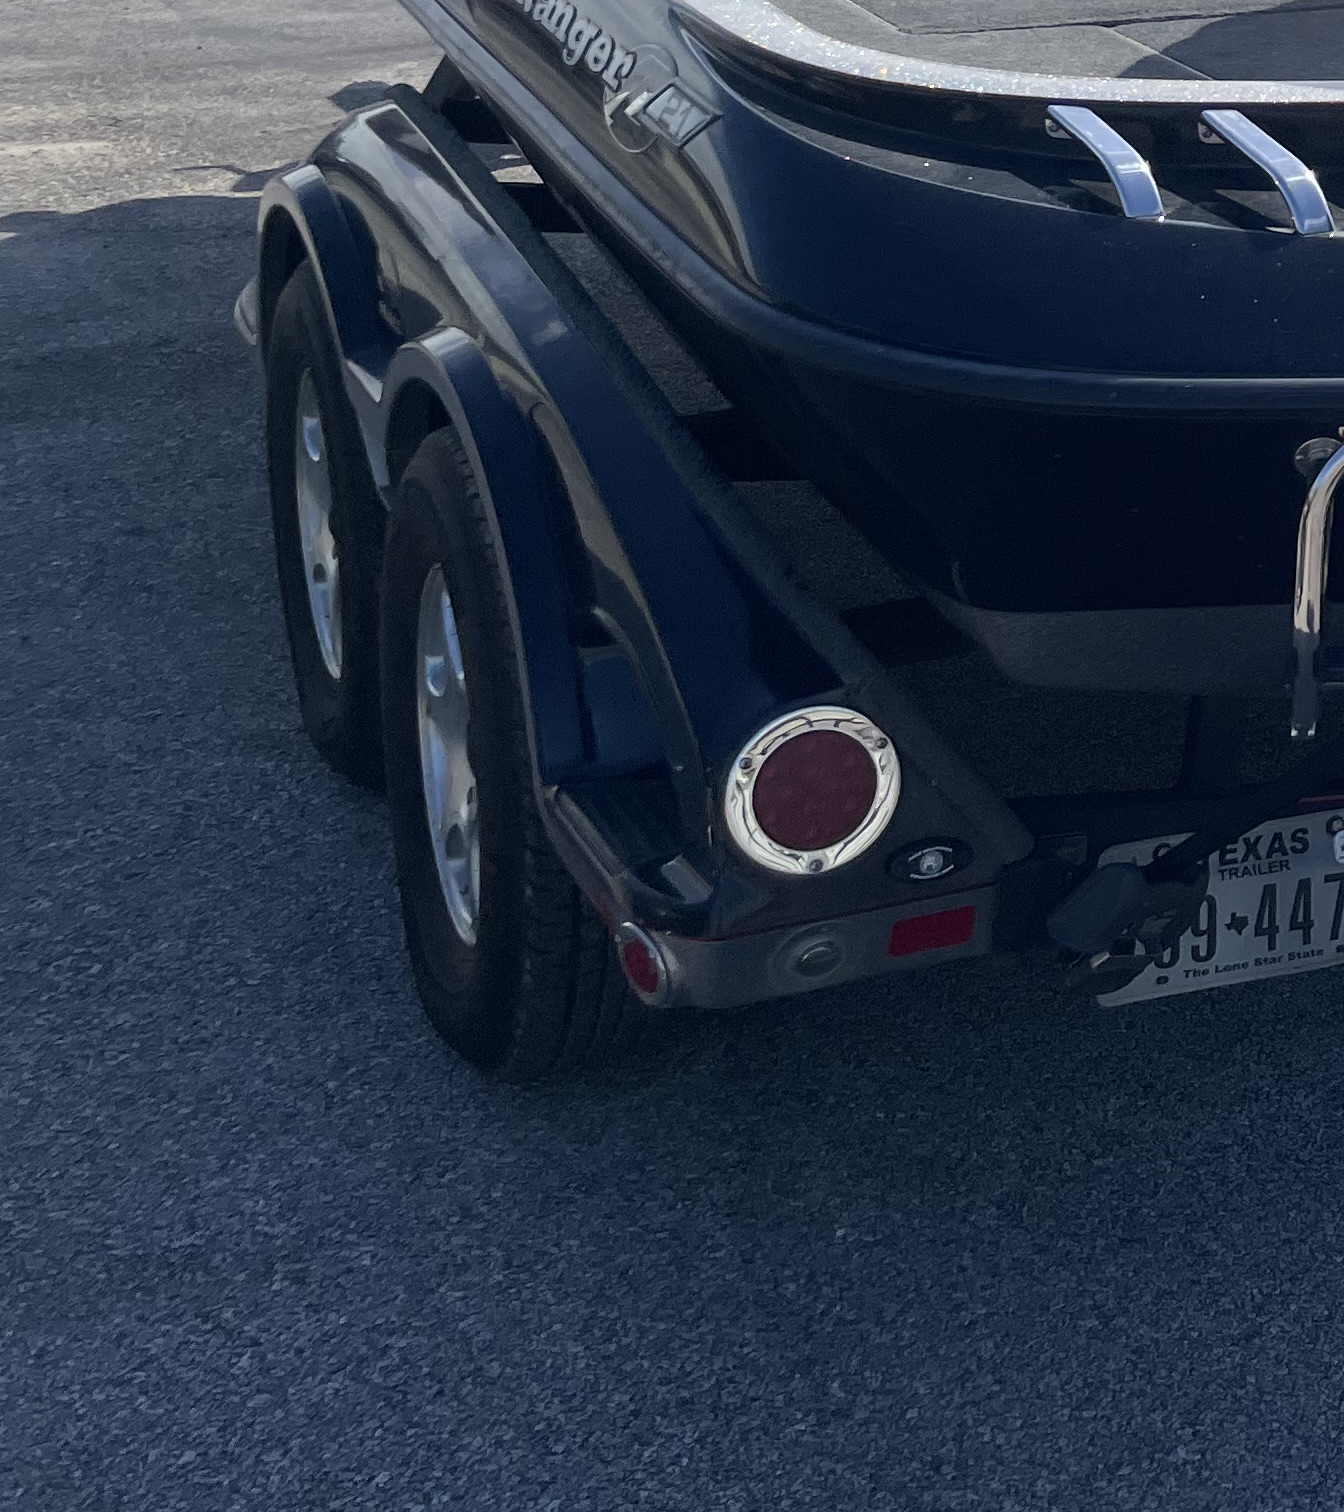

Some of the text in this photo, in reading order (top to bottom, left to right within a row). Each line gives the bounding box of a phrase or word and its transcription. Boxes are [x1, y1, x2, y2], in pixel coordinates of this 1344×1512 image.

[1218, 827, 1310, 866] EXAS
[1218, 861, 1291, 883] TRAILER
[1183, 947, 1324, 979] The Lone Star State
